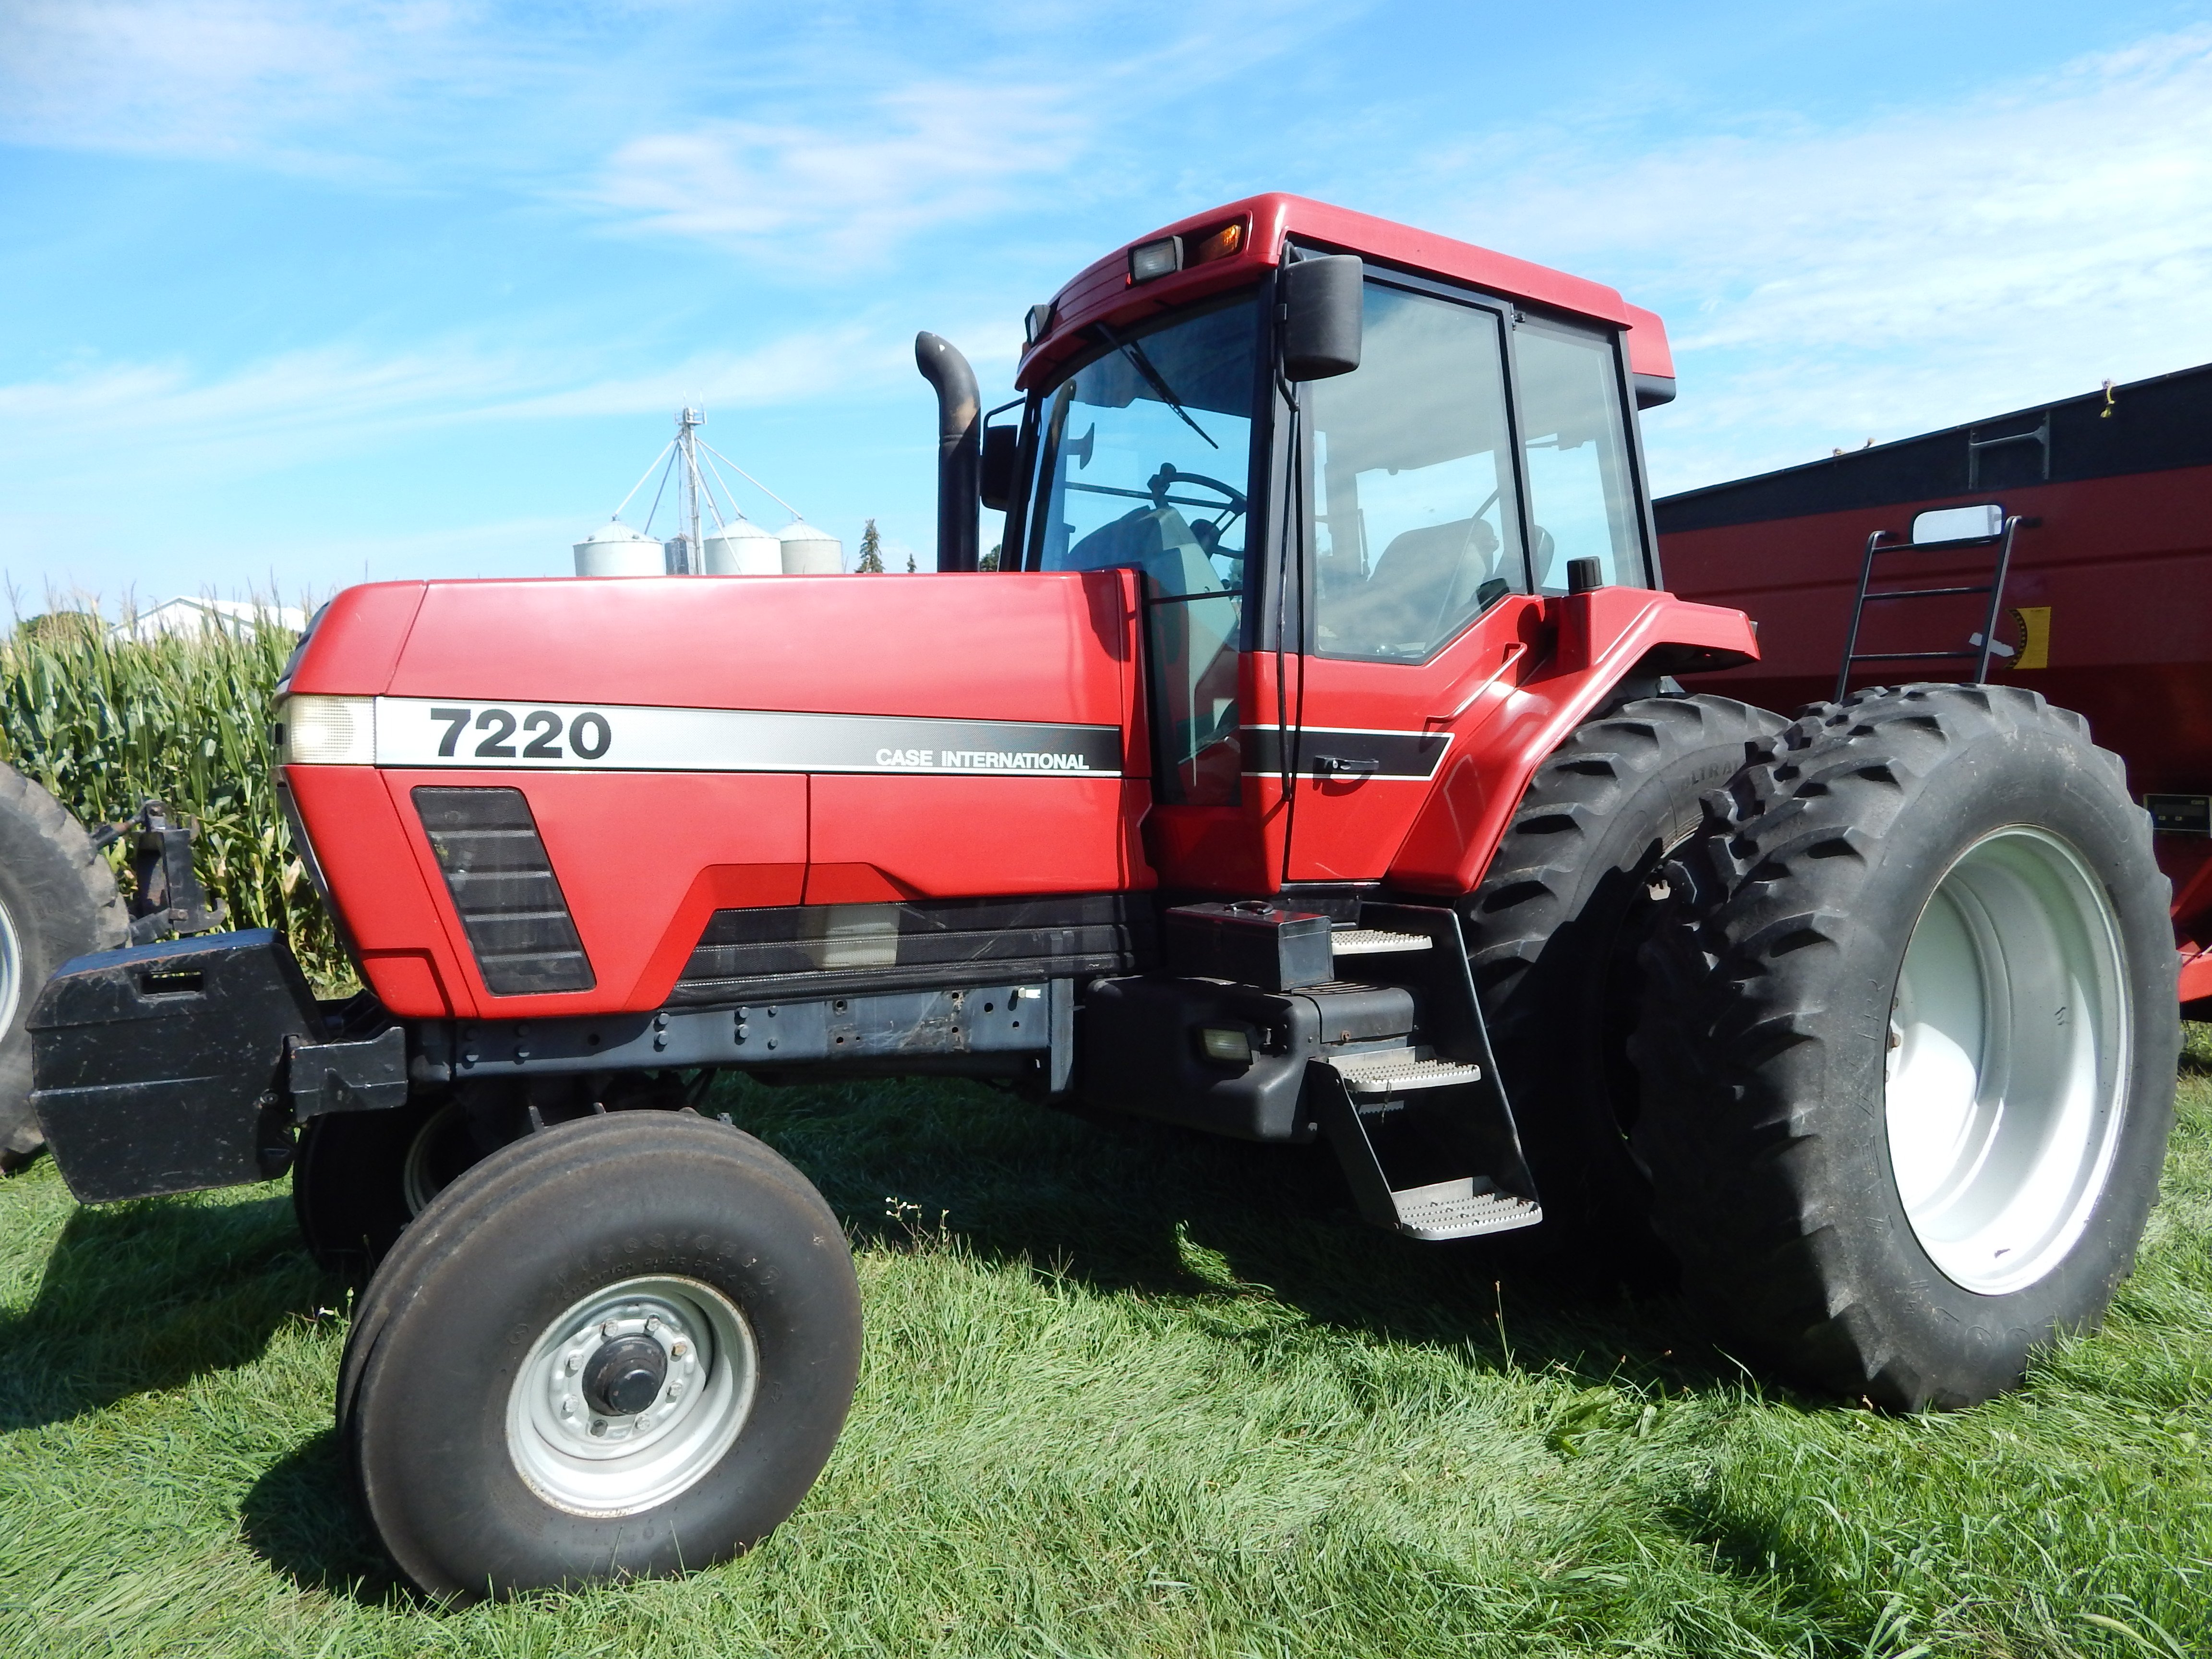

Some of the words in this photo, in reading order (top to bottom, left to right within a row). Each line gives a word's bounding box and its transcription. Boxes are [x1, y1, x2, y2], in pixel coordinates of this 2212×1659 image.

[431, 708, 612, 760] 7220
[875, 748, 933, 767] CASE
[941, 750, 1090, 769] INTERNATIONAL
